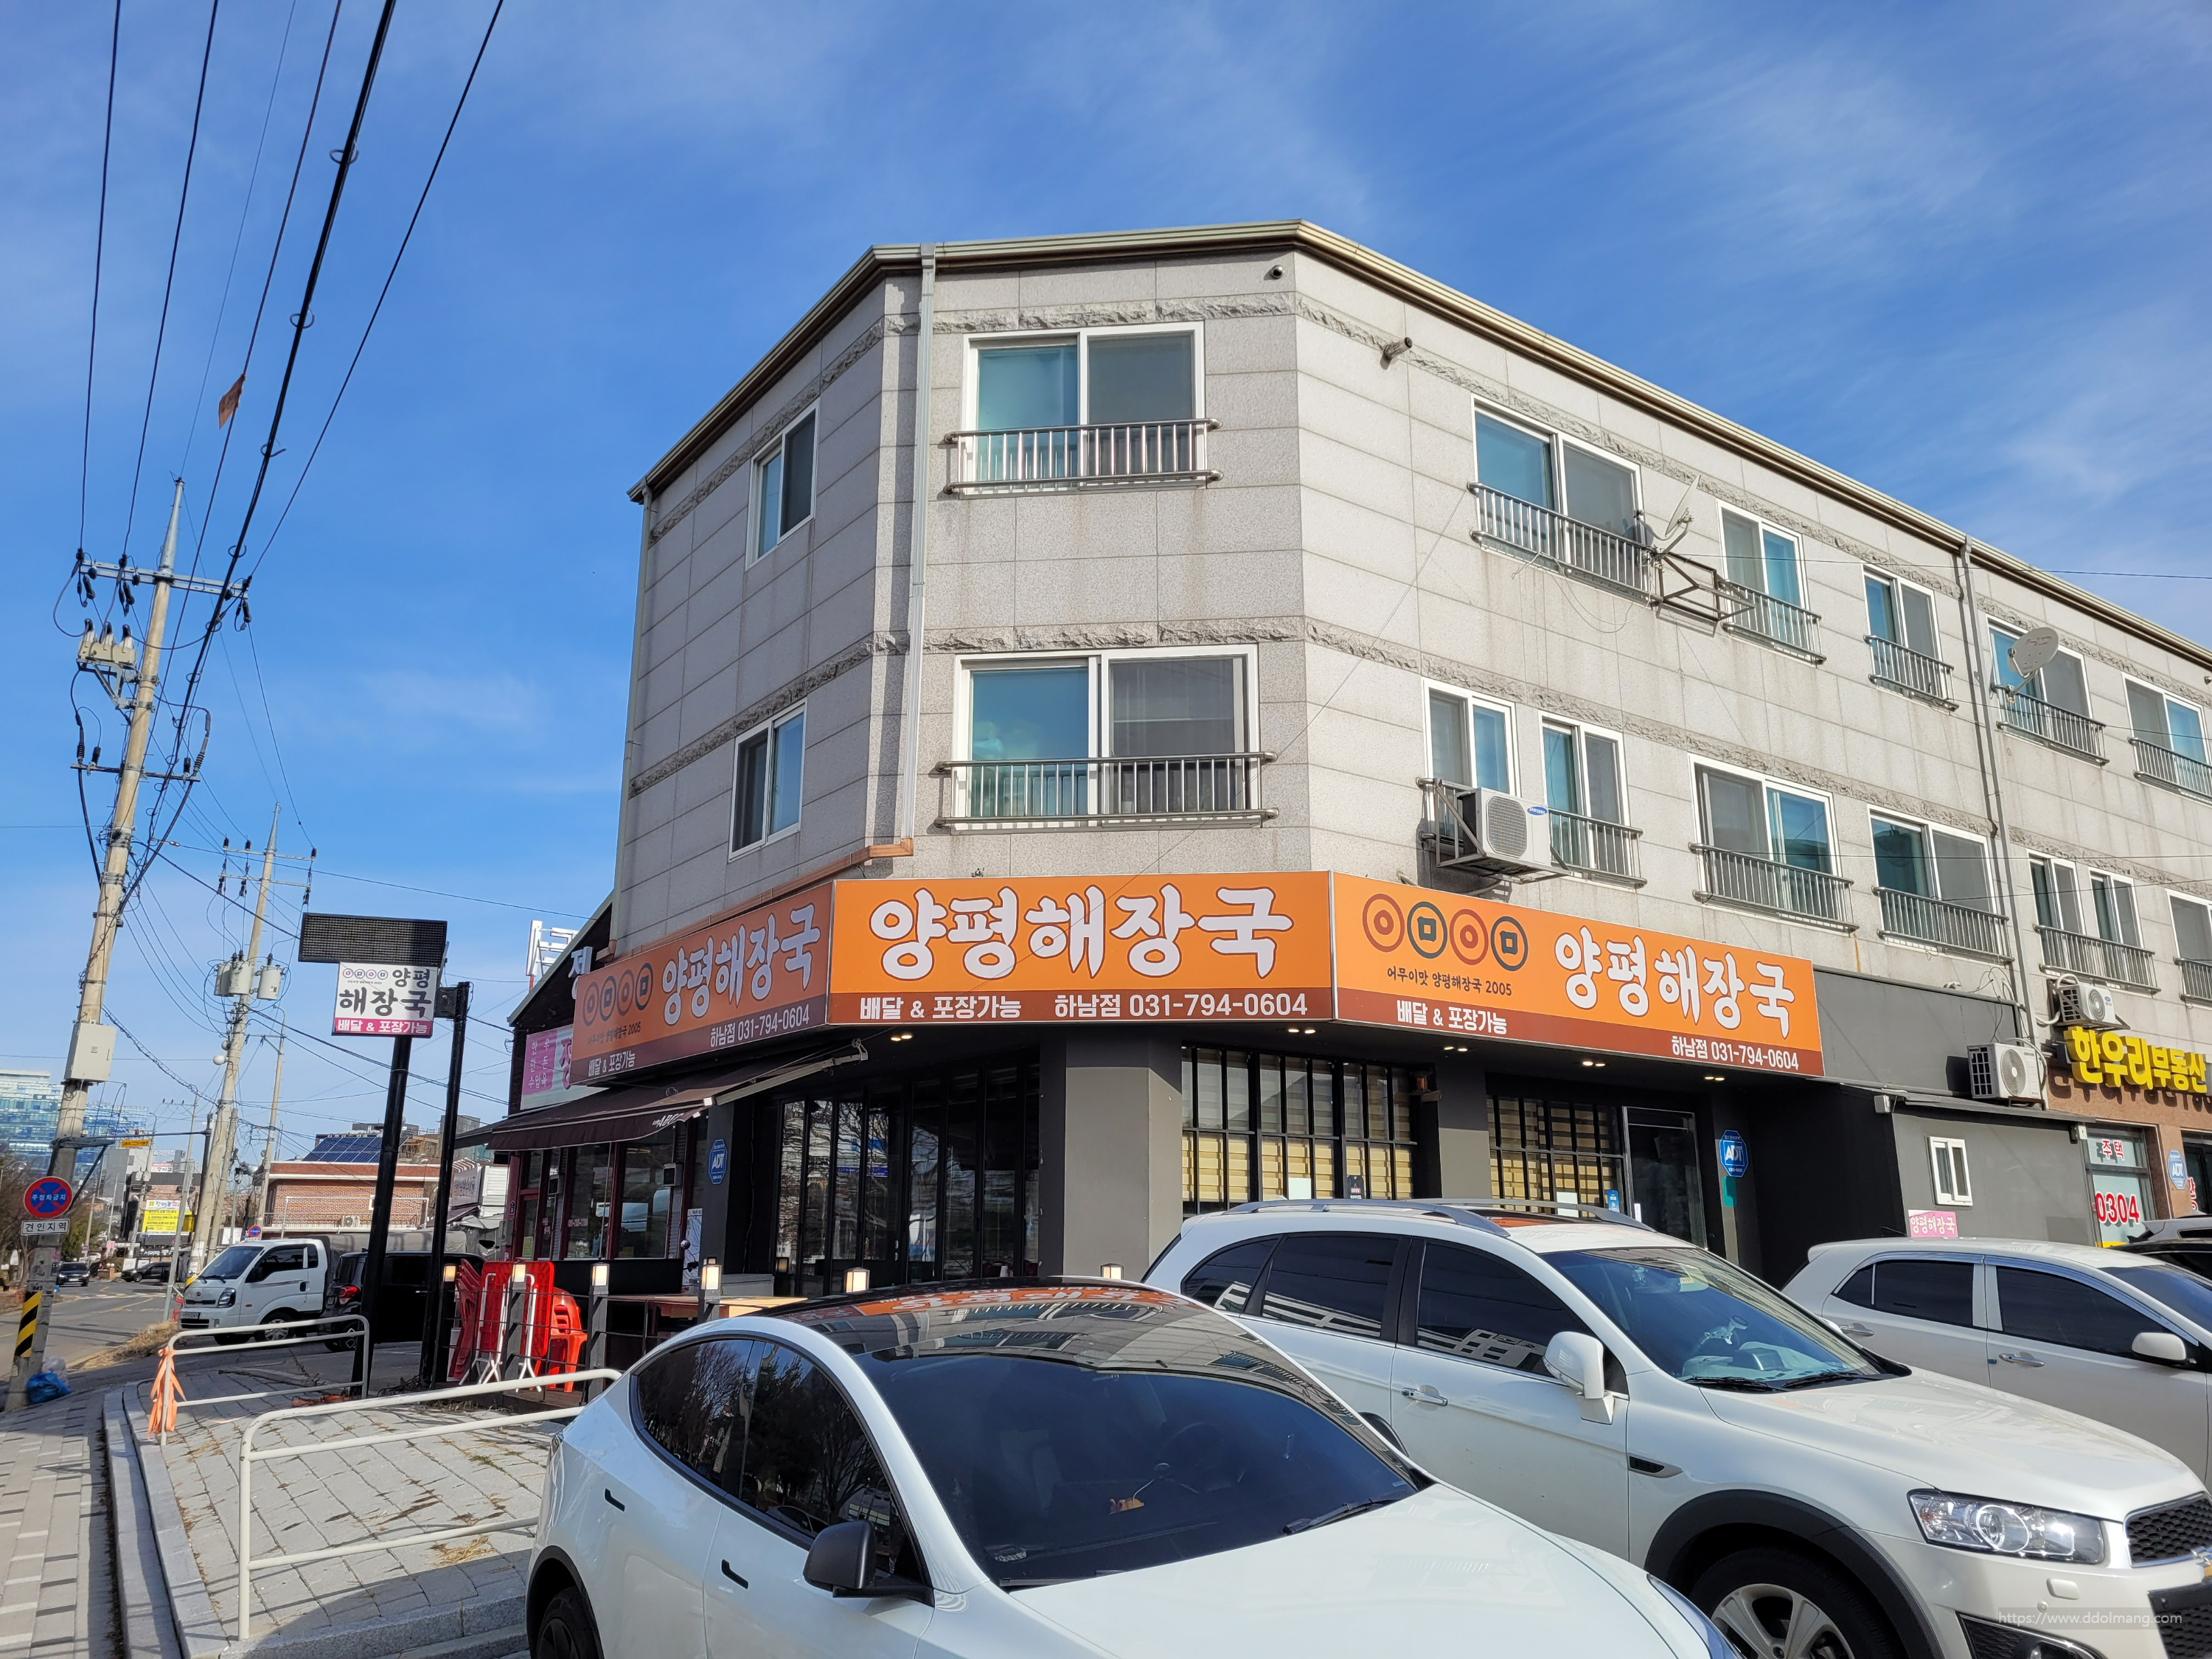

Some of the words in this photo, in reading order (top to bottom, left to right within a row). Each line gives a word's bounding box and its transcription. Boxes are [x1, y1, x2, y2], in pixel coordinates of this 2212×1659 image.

[869, 883, 1294, 981] 양평해장국
[662, 904, 820, 1025] 양평해장국
[392, 967, 430, 989] 양평
[1387, 965, 1428, 987] 어무이맛
[1432, 972, 1482, 994] 양평해장국
[1485, 981, 1512, 996] 2005
[1555, 925, 1795, 1039] 양평해장국
[339, 987, 432, 1018] 해장국
[860, 996, 903, 1020] 배달
[910, 1001, 925, 1019] &
[932, 995, 1021, 1019] 포장가능
[1054, 994, 1121, 1018] 하남점
[1130, 992, 1307, 1017] 031-794-0604
[338, 1019, 363, 1032] 배달
[366, 1022, 375, 1032] &
[378, 1020, 428, 1034] 포장가능
[627, 1021, 641, 1035] 2005
[710, 1023, 735, 1048] 하남점
[737, 1004, 810, 1041] 031-794-0604
[1397, 1000, 1427, 1026] 배달
[1433, 1008, 1444, 1026] &
[1448, 1006, 1507, 1035] 포장가능
[588, 1057, 602, 1077] 배달
[602, 1060, 607, 1073] &
[608, 1050, 636, 1073] 포장가능
[1672, 1035, 1707, 1059] 하남점
[1711, 1041, 1798, 1071] 031-794-0604
[2063, 1026, 2208, 1093] 한우리부동산
[528, 1073, 548, 1089] 수입육
[712, 1152, 725, 1169] ADT
[1725, 1144, 1743, 1162] ADT
[2101, 1139, 2124, 1161] 주택
[2172, 1162, 2183, 1177] ADT
[2095, 1192, 2140, 1224] 0304
[25, 1221, 66, 1232] 견인지역
[1910, 1214, 1955, 1236] 양평해장국
